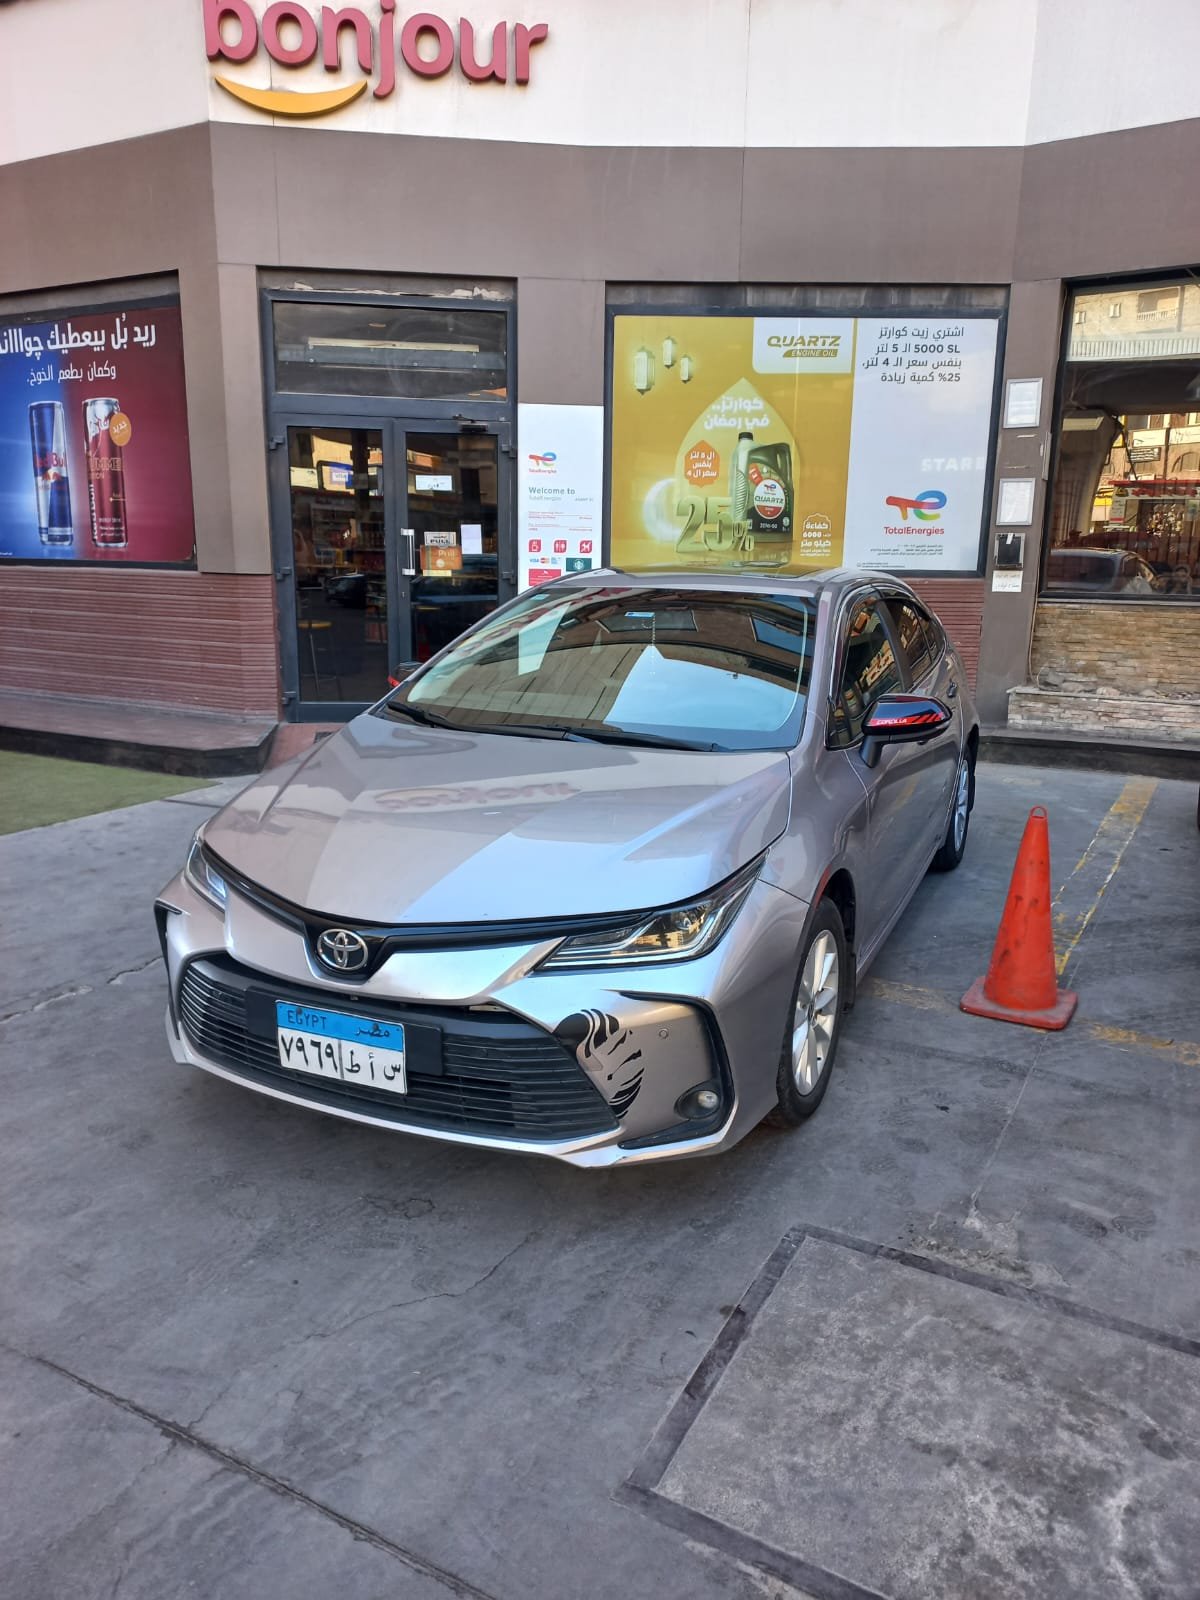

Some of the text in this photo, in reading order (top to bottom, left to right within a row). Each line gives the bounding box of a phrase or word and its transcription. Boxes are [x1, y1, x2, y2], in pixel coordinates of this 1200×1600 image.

[202, 0, 548, 98] bonjour
[47, 322, 105, 354] بيعطيك
[133, 324, 156, 347] ريد
[879, 326, 964, 341] اشتري زيت كوارتز
[767, 336, 841, 348] QUARTZ
[791, 348, 836, 357] ENGINE OIL
[875, 344, 888, 355] لتر
[892, 345, 898, 353] 5
[914, 345, 944, 353] 5000
[947, 345, 960, 353] SL
[882, 358, 889, 366] 4
[907, 359, 928, 369] سعر
[932, 358, 962, 369] بنفس
[58, 363, 83, 383] بطعم
[88, 360, 116, 381] وكمان
[880, 372, 906, 384] زيادة
[910, 372, 934, 384] كمية
[704, 415, 770, 430] في رمضان
[528, 486, 564, 494] Welcome
[754, 495, 785, 504] QUARTZ
[884, 526, 944, 536] TotalEnergies
[288, 1010, 327, 1029] EGYPT
[355, 1024, 390, 1038] مصر
[281, 1034, 338, 1072] ٧٩٦٩
[345, 1050, 360, 1073] ط
[384, 1063, 400, 1080] س
